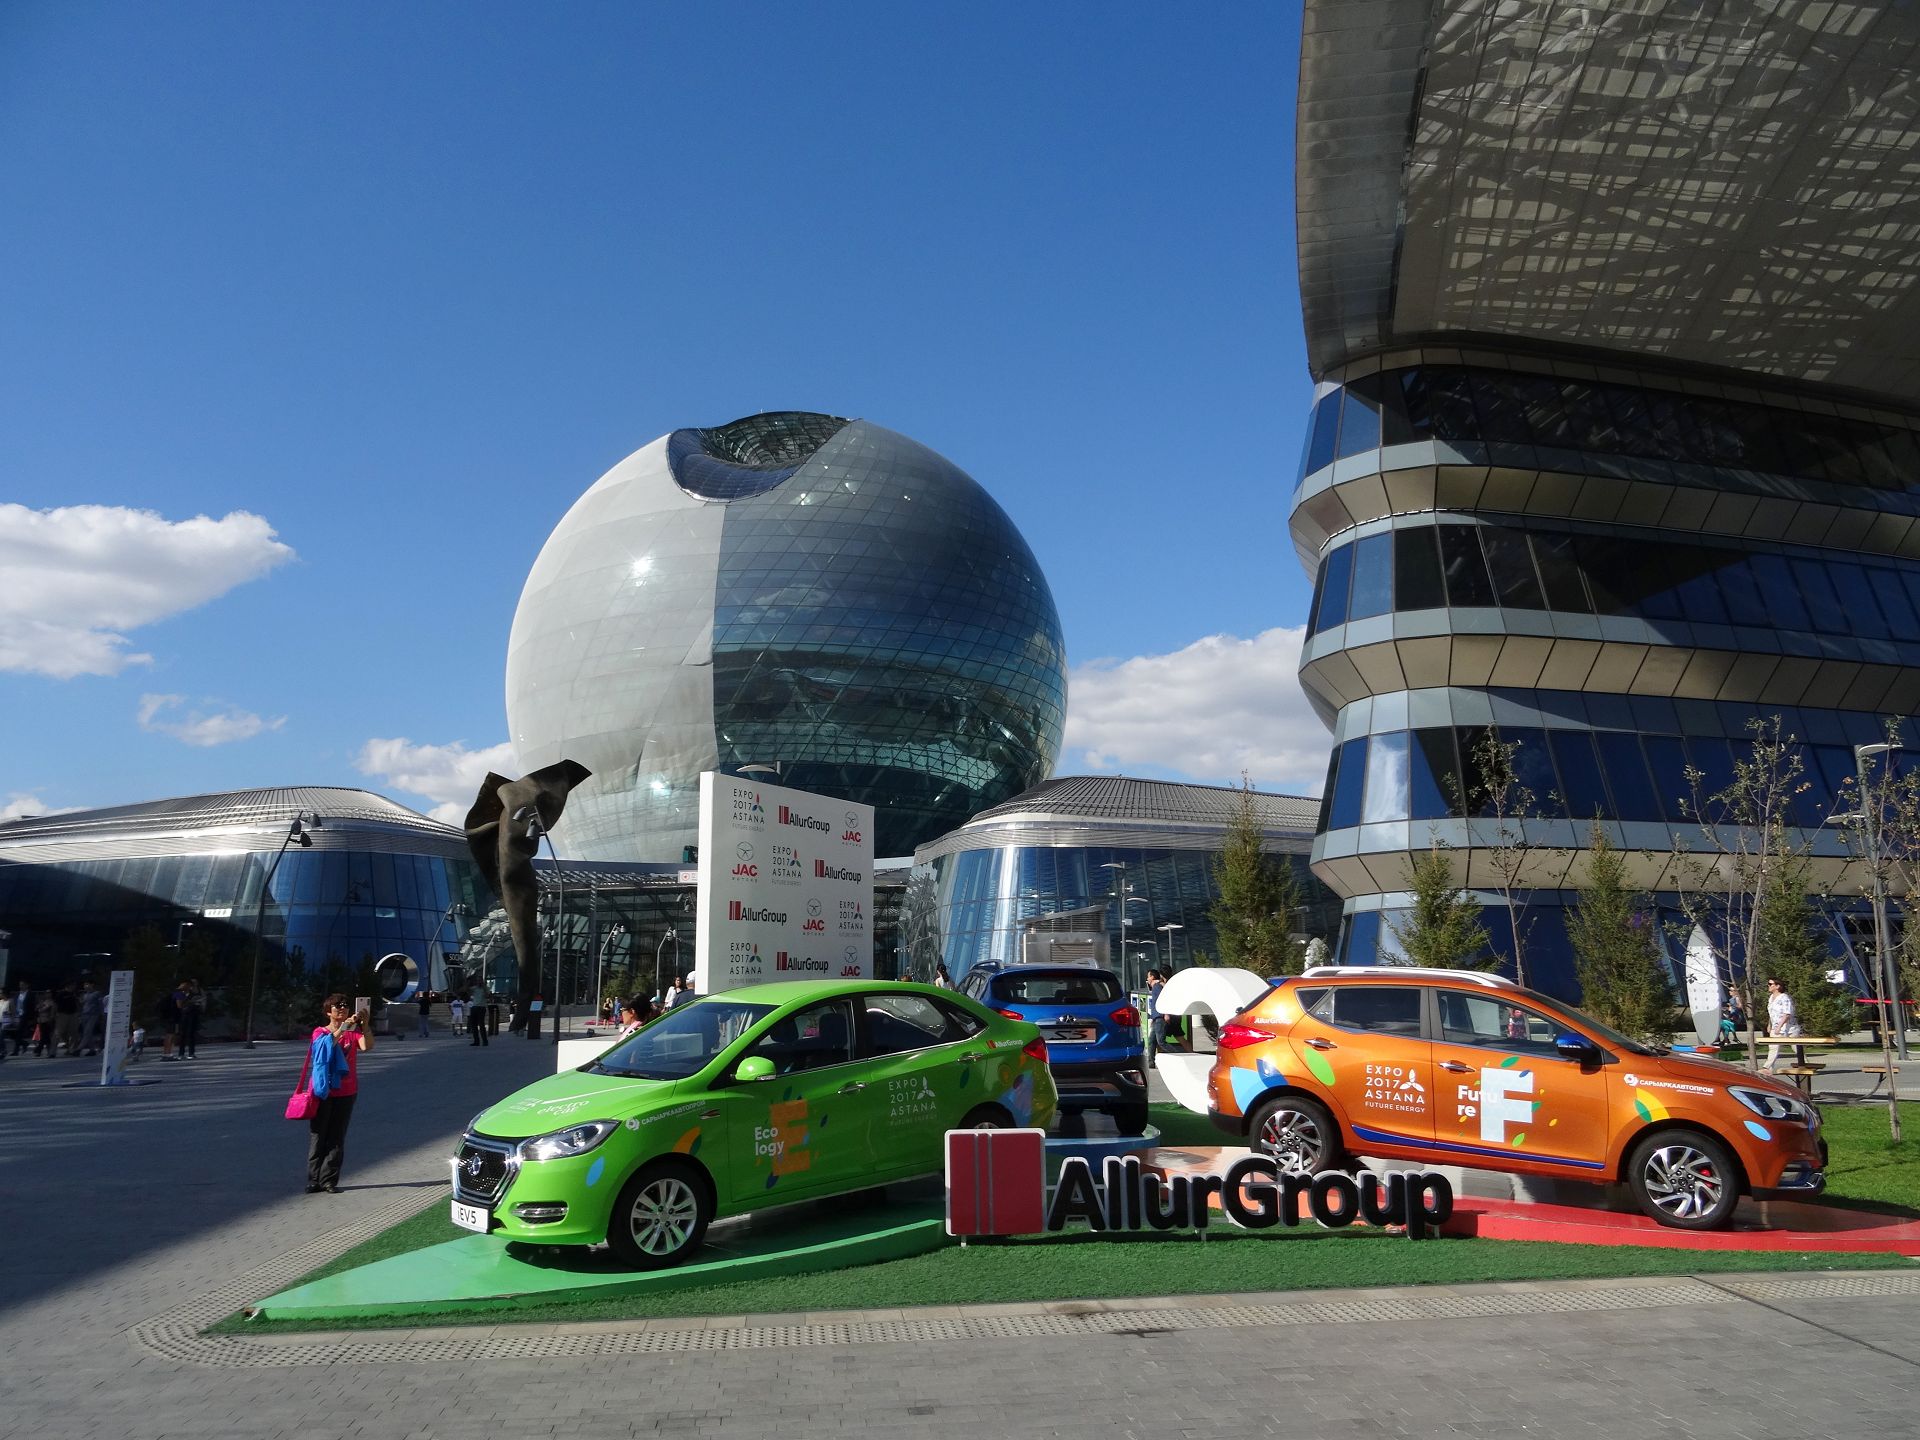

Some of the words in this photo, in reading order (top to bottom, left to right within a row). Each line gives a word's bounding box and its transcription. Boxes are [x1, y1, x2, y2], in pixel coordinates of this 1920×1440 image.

[733, 788, 753, 800] EXPO
[733, 799, 752, 811] 2017
[732, 812, 765, 825] ASTANA
[789, 812, 831, 835] AllurGroup
[841, 830, 862, 842] JAC
[772, 845, 791, 856] EXPO
[772, 856, 791, 866] 2017
[731, 863, 758, 877] JAC
[772, 868, 802, 878] ASTANA
[824, 865, 862, 885] AllurGroup
[839, 900, 855, 910] EXPO
[740, 907, 788, 926] AllurGroup
[839, 911, 854, 920] 2017
[802, 918, 825, 931] JAC
[838, 921, 864, 930] ASTANA
[730, 942, 751, 952] EXPO
[730, 954, 750, 963] 2017
[729, 965, 762, 975] ASTANA
[787, 957, 829, 974] AllurGroup
[840, 965, 861, 977] JAC
[1366, 1064, 1403, 1077] EXPO
[888, 1078, 918, 1091] EXPO
[1365, 1076, 1401, 1089] 2017
[890, 1090, 917, 1104] 2017
[1364, 1089, 1425, 1104] ASTANA
[890, 1100, 937, 1117] ASTANA
[1365, 1101, 1394, 1110] FUTURE
[1395, 1104, 1425, 1113] ENERGY
[1457, 1104, 1477, 1117] re
[754, 1126, 779, 1141] Eco
[755, 1141, 785, 1157] logy
[1047, 1153, 1454, 1241] AllurGroup
[457, 1205, 477, 1225] iEV5
